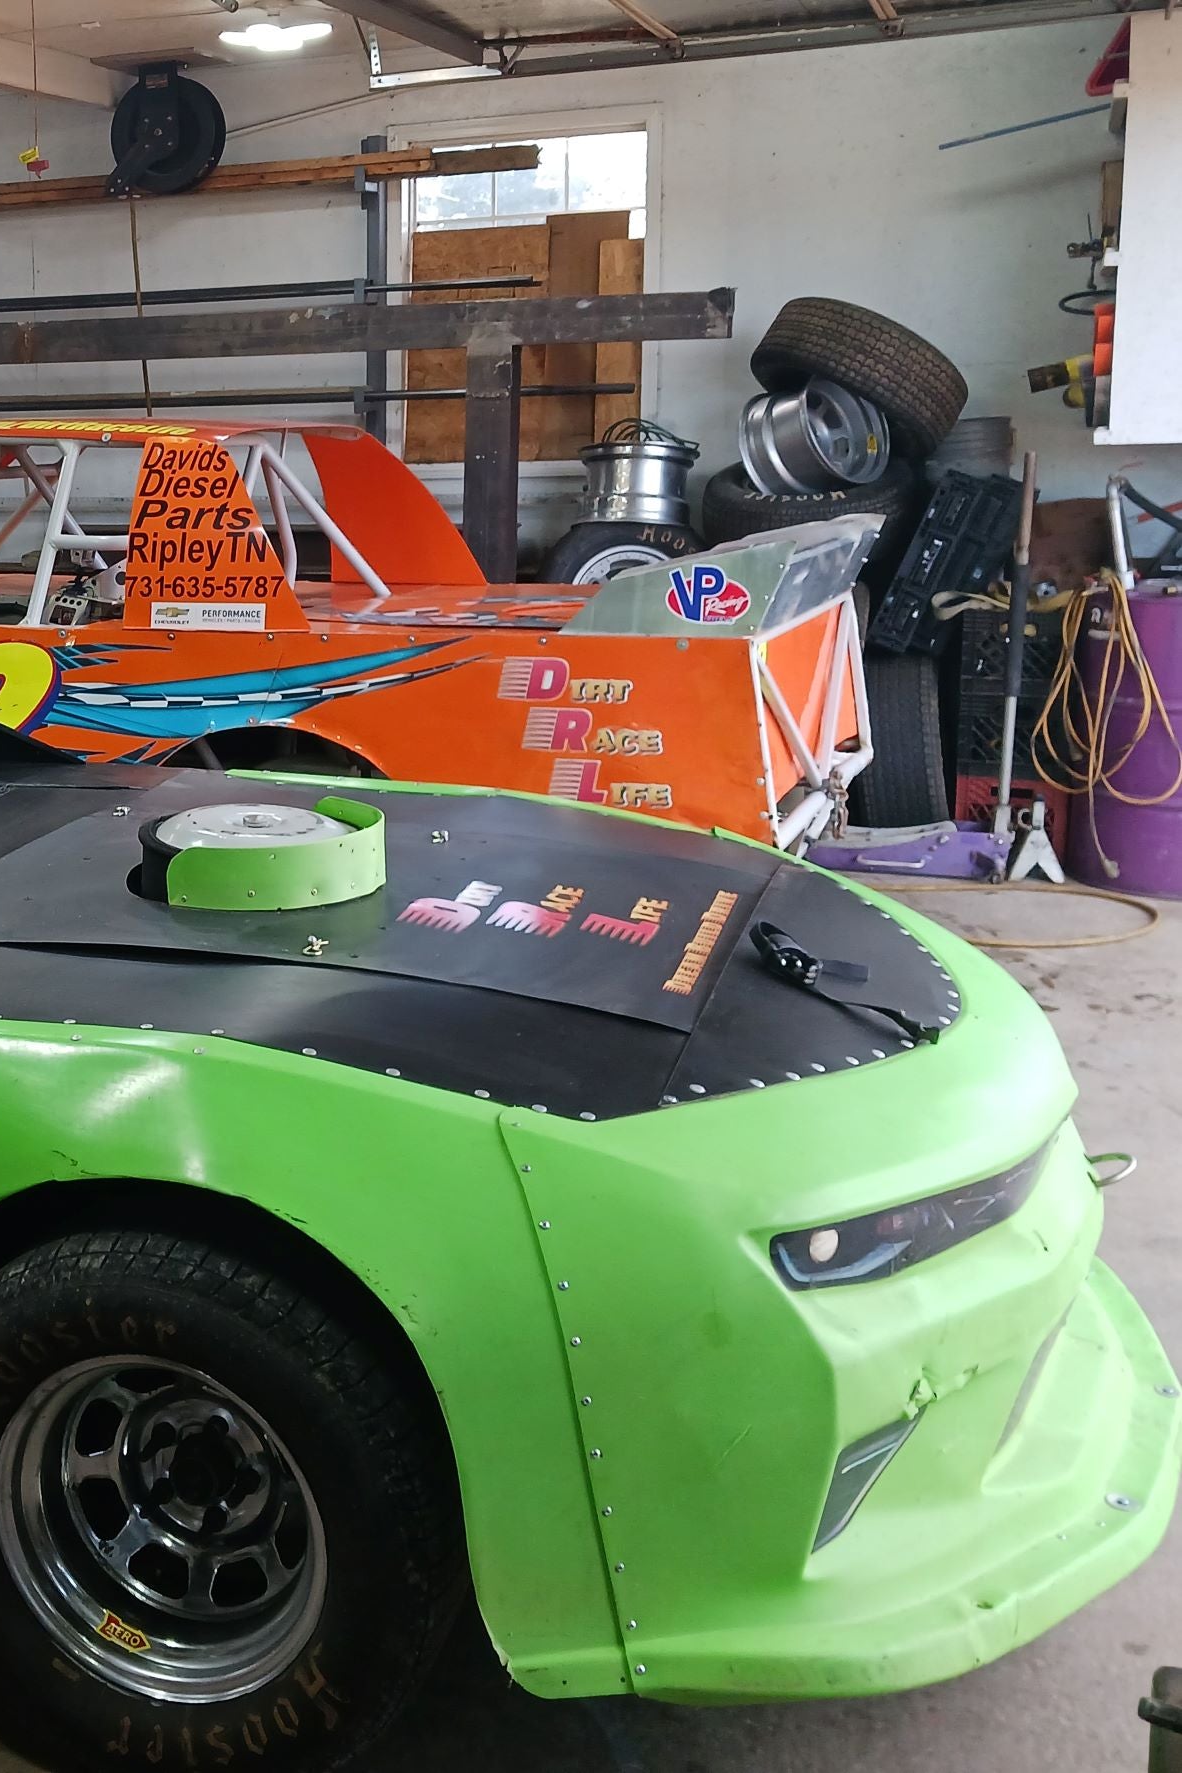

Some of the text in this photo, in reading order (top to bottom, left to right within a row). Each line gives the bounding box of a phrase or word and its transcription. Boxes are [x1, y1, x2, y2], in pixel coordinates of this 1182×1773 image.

[143, 442, 230, 472] Davids
[139, 469, 240, 499] Diesel
[134, 500, 254, 530] Parts
[125, 575, 285, 599] 731-635-5787
[670, 565, 726, 623] VP
[202, 609, 261, 618] PERFORMANCE
[104, 1621, 141, 1647] AERO
